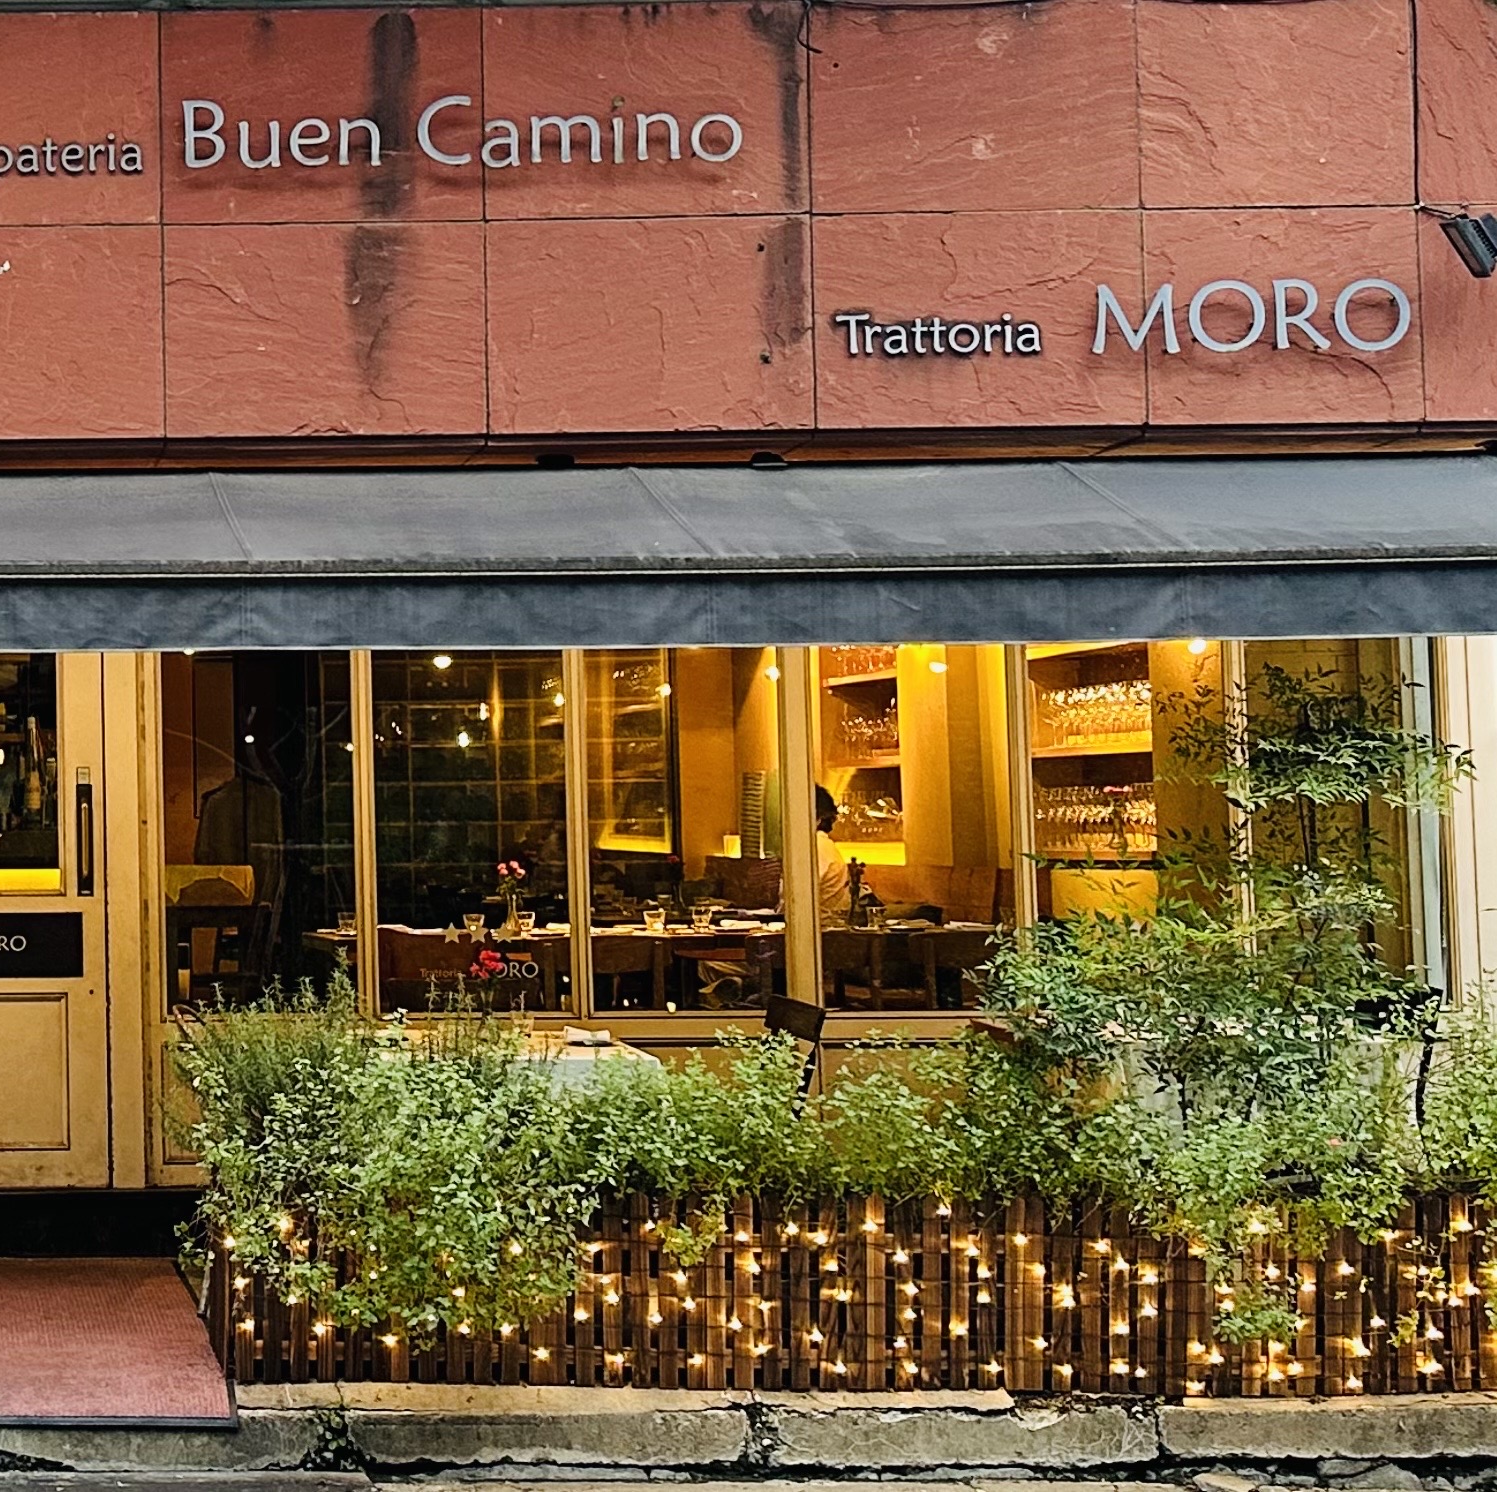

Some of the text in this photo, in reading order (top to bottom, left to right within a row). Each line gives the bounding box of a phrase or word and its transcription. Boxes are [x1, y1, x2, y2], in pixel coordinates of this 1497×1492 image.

[181, 99, 382, 169] Buen
[416, 94, 743, 168] Camino
[835, 278, 1412, 357] Trattoria MORO
